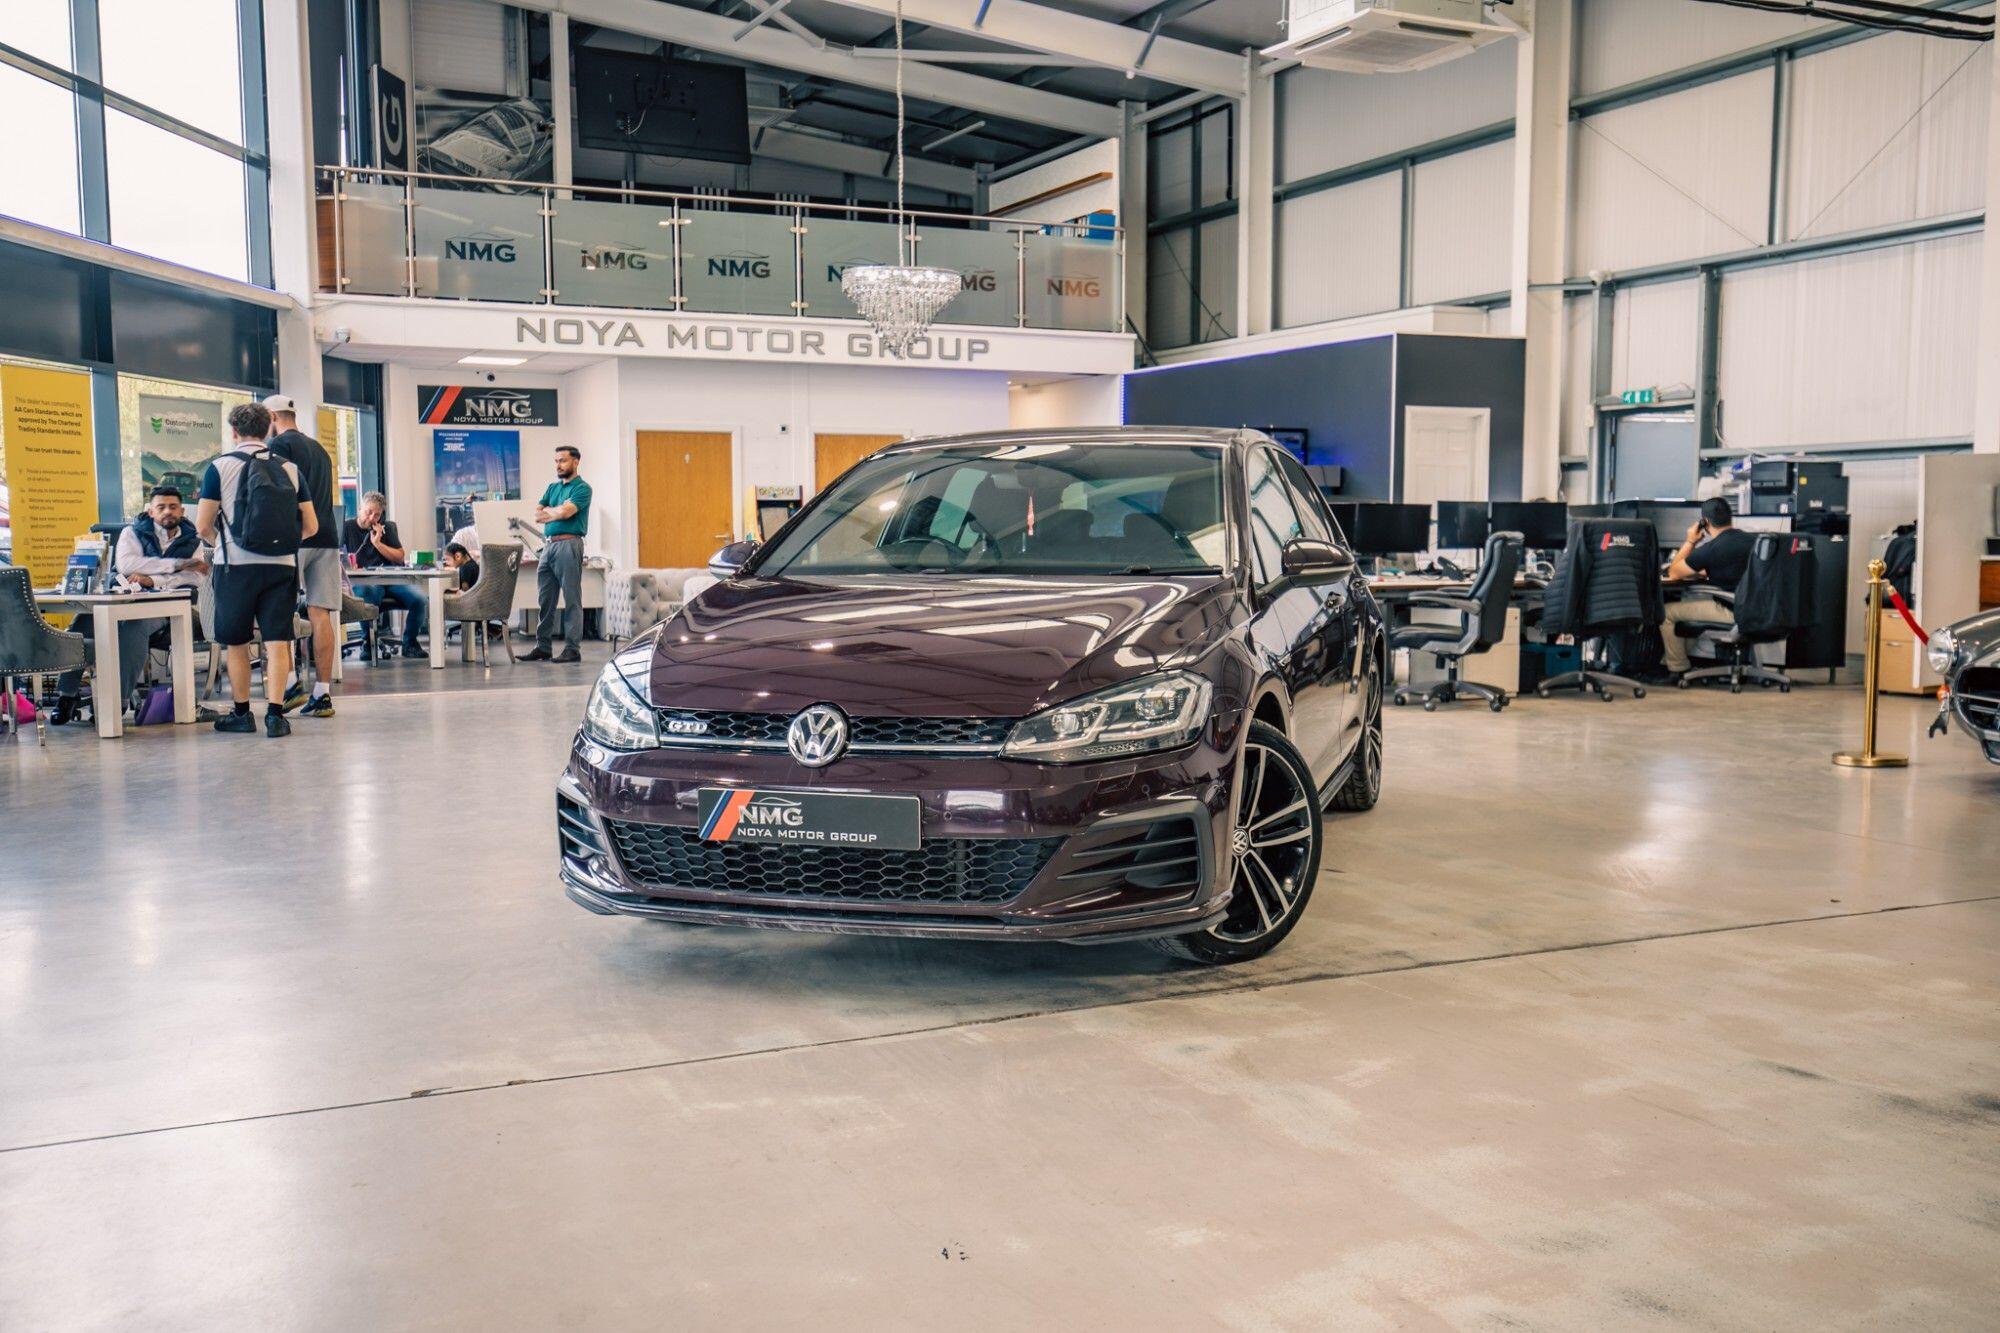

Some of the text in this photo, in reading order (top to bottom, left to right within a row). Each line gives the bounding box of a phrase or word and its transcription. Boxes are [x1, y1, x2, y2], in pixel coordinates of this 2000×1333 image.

[445, 239, 516, 263] NMG
[581, 249, 648, 271] NMG
[708, 257, 771, 279] NMG
[961, 274, 996, 292] MG
[1046, 279, 1100, 298] NMG
[516, 317, 644, 348] NOYA
[668, 324, 825, 356] MOTOR
[464, 398, 532, 417] NMG
[165, 418, 214, 429] Customer Protect
[480, 416, 511, 424] MOTOR
[513, 417, 544, 425] GROUP
[738, 804, 804, 826] NMG
[737, 827, 878, 842] NOYA MOTOR GROUP
